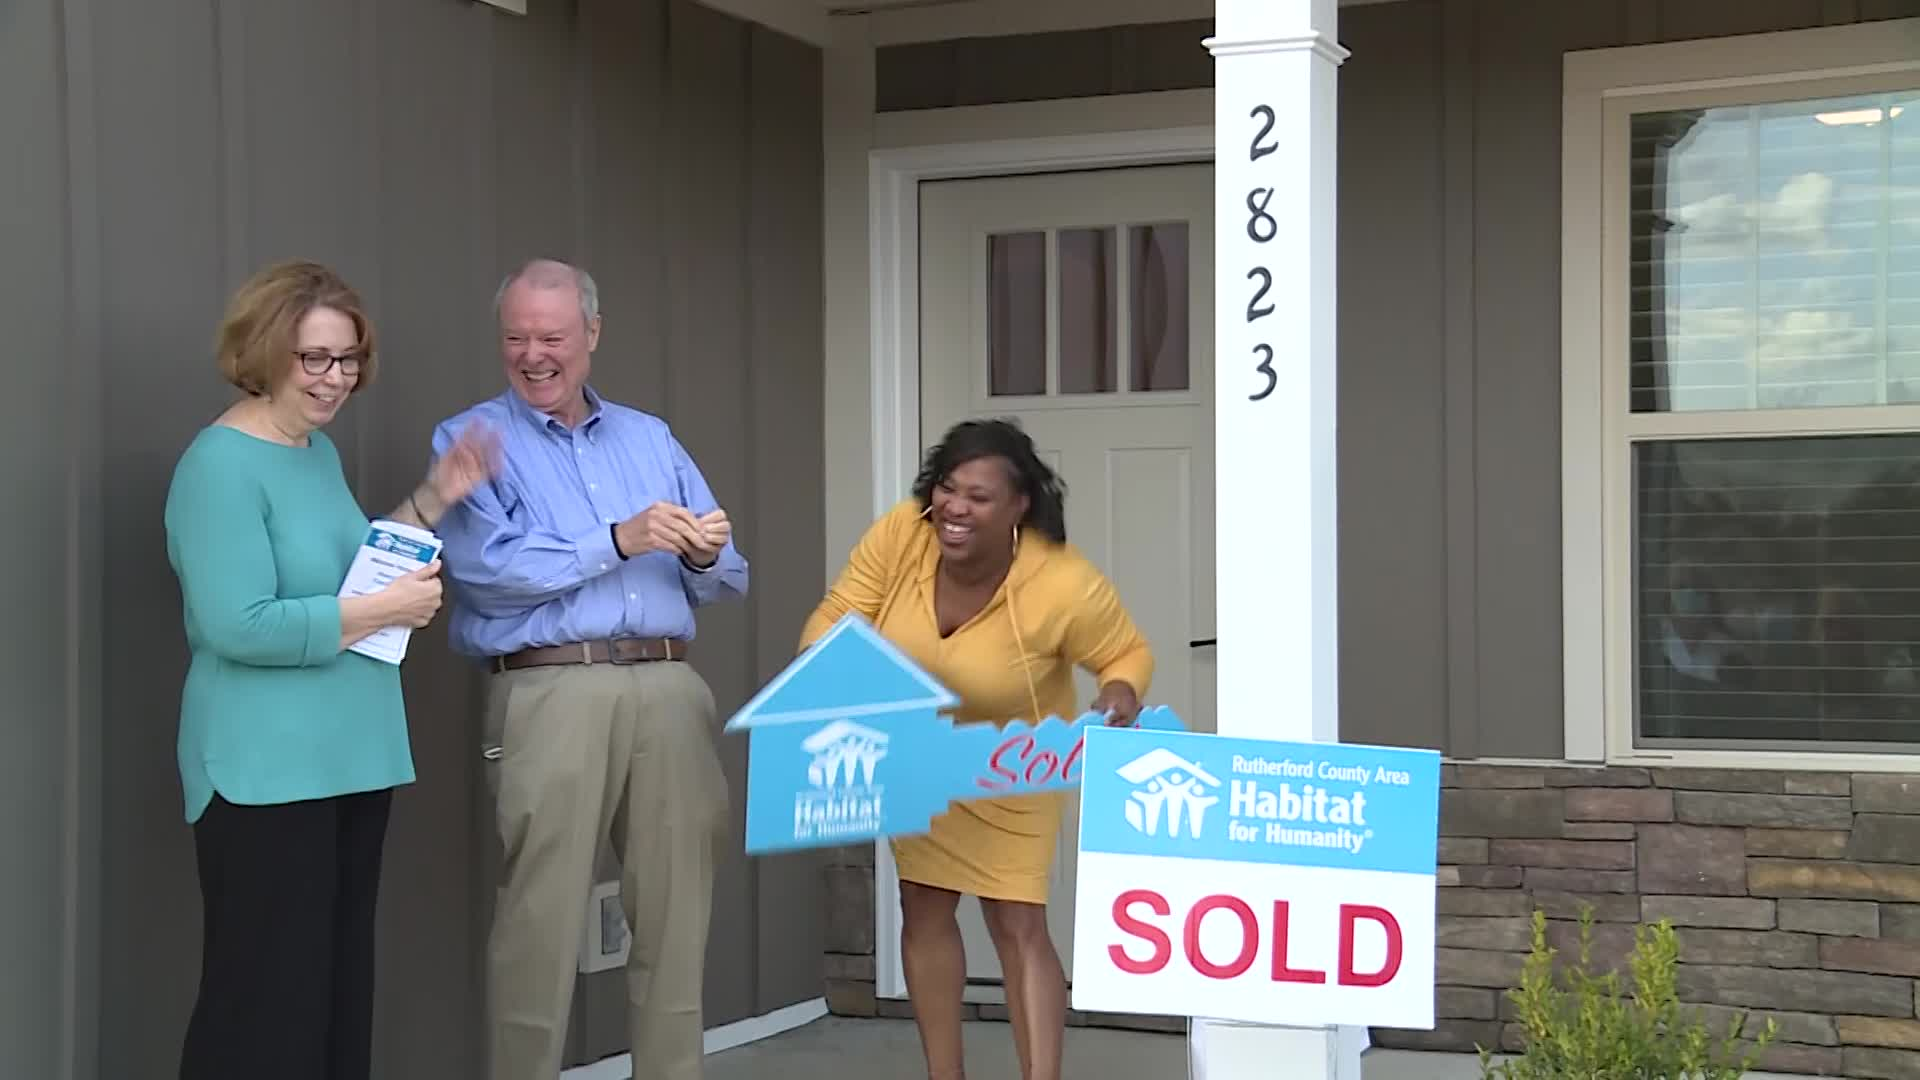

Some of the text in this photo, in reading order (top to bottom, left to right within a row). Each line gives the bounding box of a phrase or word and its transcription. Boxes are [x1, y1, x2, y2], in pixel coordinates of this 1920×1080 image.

[1246, 104, 1280, 401] 2823
[976, 733, 1085, 787] Sol
[1232, 753, 1411, 786] Rutherford County Area
[794, 792, 881, 824] Habitat
[1229, 778, 1368, 826] Habitat
[1229, 819, 1260, 842] for
[1107, 888, 1404, 988] SOLD
